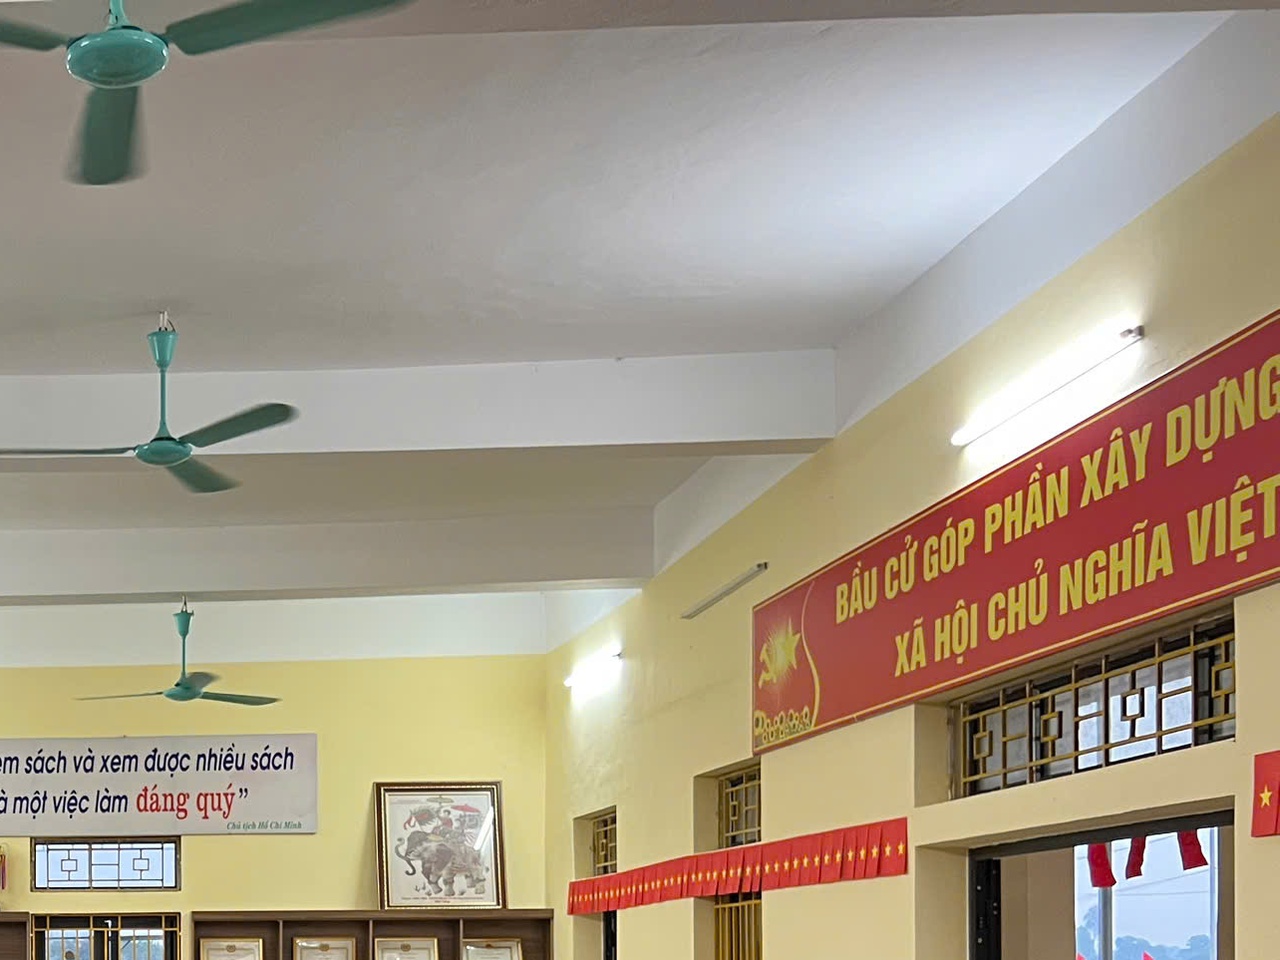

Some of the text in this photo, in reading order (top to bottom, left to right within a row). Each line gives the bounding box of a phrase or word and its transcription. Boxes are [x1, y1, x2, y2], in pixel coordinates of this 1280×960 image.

[836, 353, 1280, 624] BẦU CỬ GÓP PHẦN XÂY DỰNG
[895, 474, 1280, 677] XÃ HỘI CHỦ NGHĨA VIỆT
[24, 748, 67, 774] sách
[73, 747, 95, 774] và
[99, 753, 139, 773] xem
[144, 748, 191, 778] được
[196, 743, 246, 772] nhiều
[250, 744, 294, 771] sách
[12, 790, 48, 820] một
[52, 790, 90, 819] việc
[94, 787, 129, 814] làm
[136, 784, 190, 820] đáng
[283, 820, 302, 830] Minh
